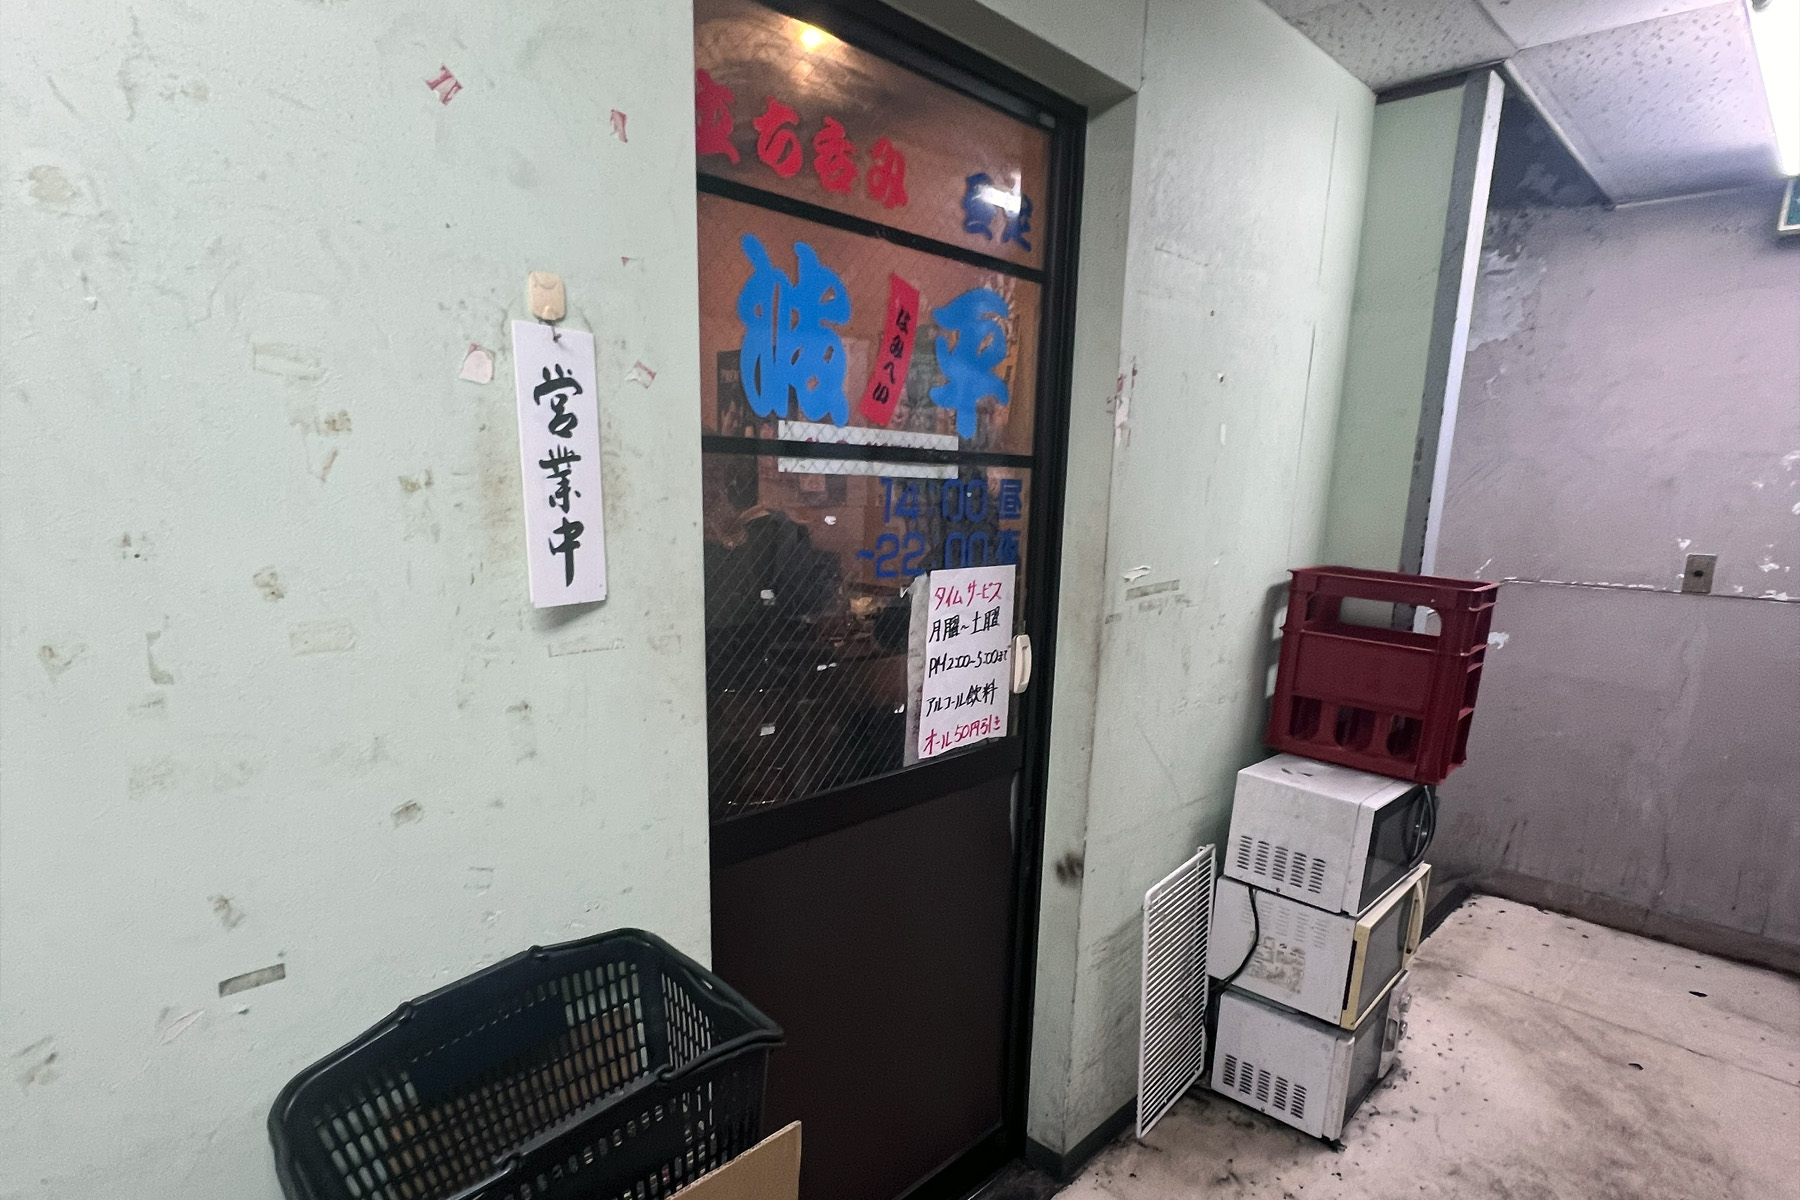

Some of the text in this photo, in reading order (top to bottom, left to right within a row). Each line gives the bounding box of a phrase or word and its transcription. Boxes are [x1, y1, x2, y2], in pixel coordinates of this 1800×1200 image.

[533, 363, 584, 588] 営業中
[925, 678, 999, 718] アルコール飲料
[923, 713, 1001, 756] オール50円引き
